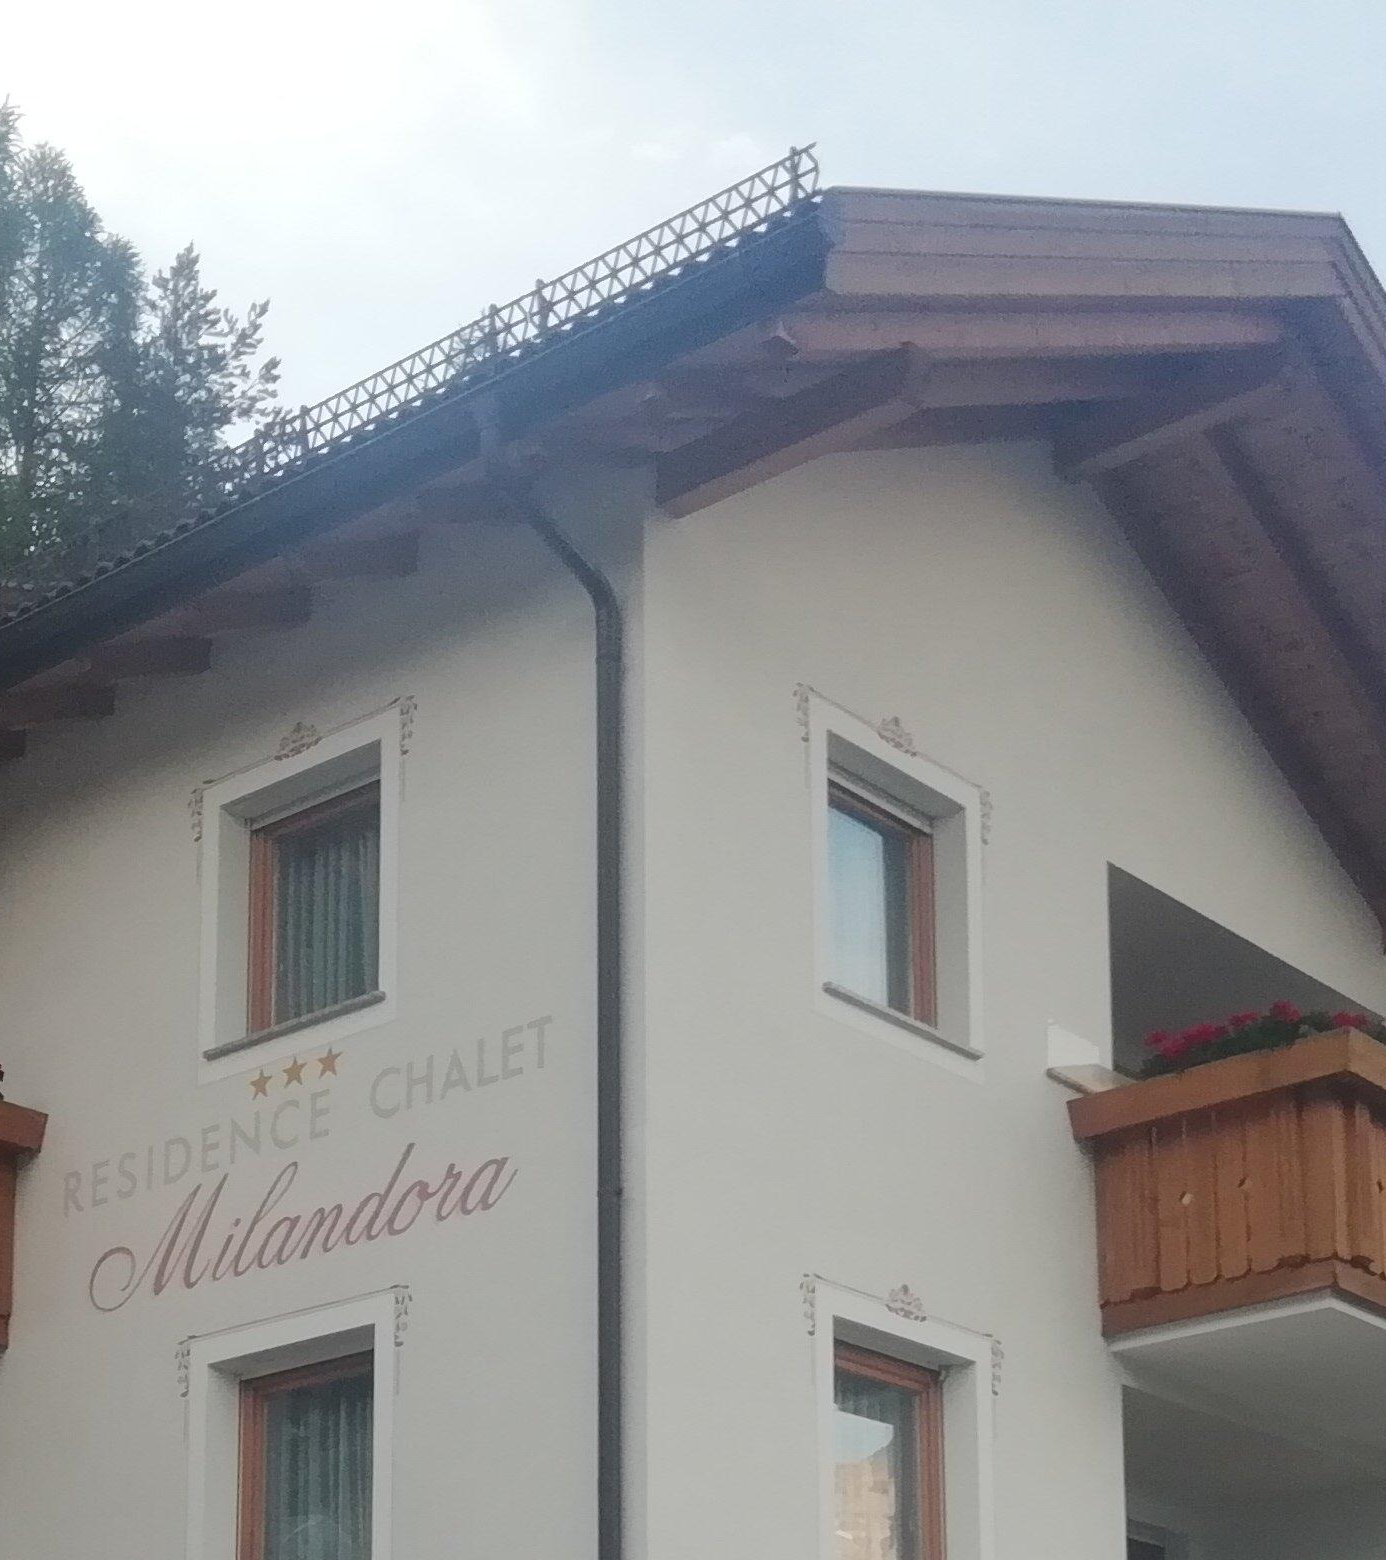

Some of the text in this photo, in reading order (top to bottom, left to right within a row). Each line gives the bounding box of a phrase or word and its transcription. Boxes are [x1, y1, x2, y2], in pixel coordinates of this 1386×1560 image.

[62, 1015, 554, 1217] RESIDENCE CHALET
[88, 1142, 519, 1312] Milandora
